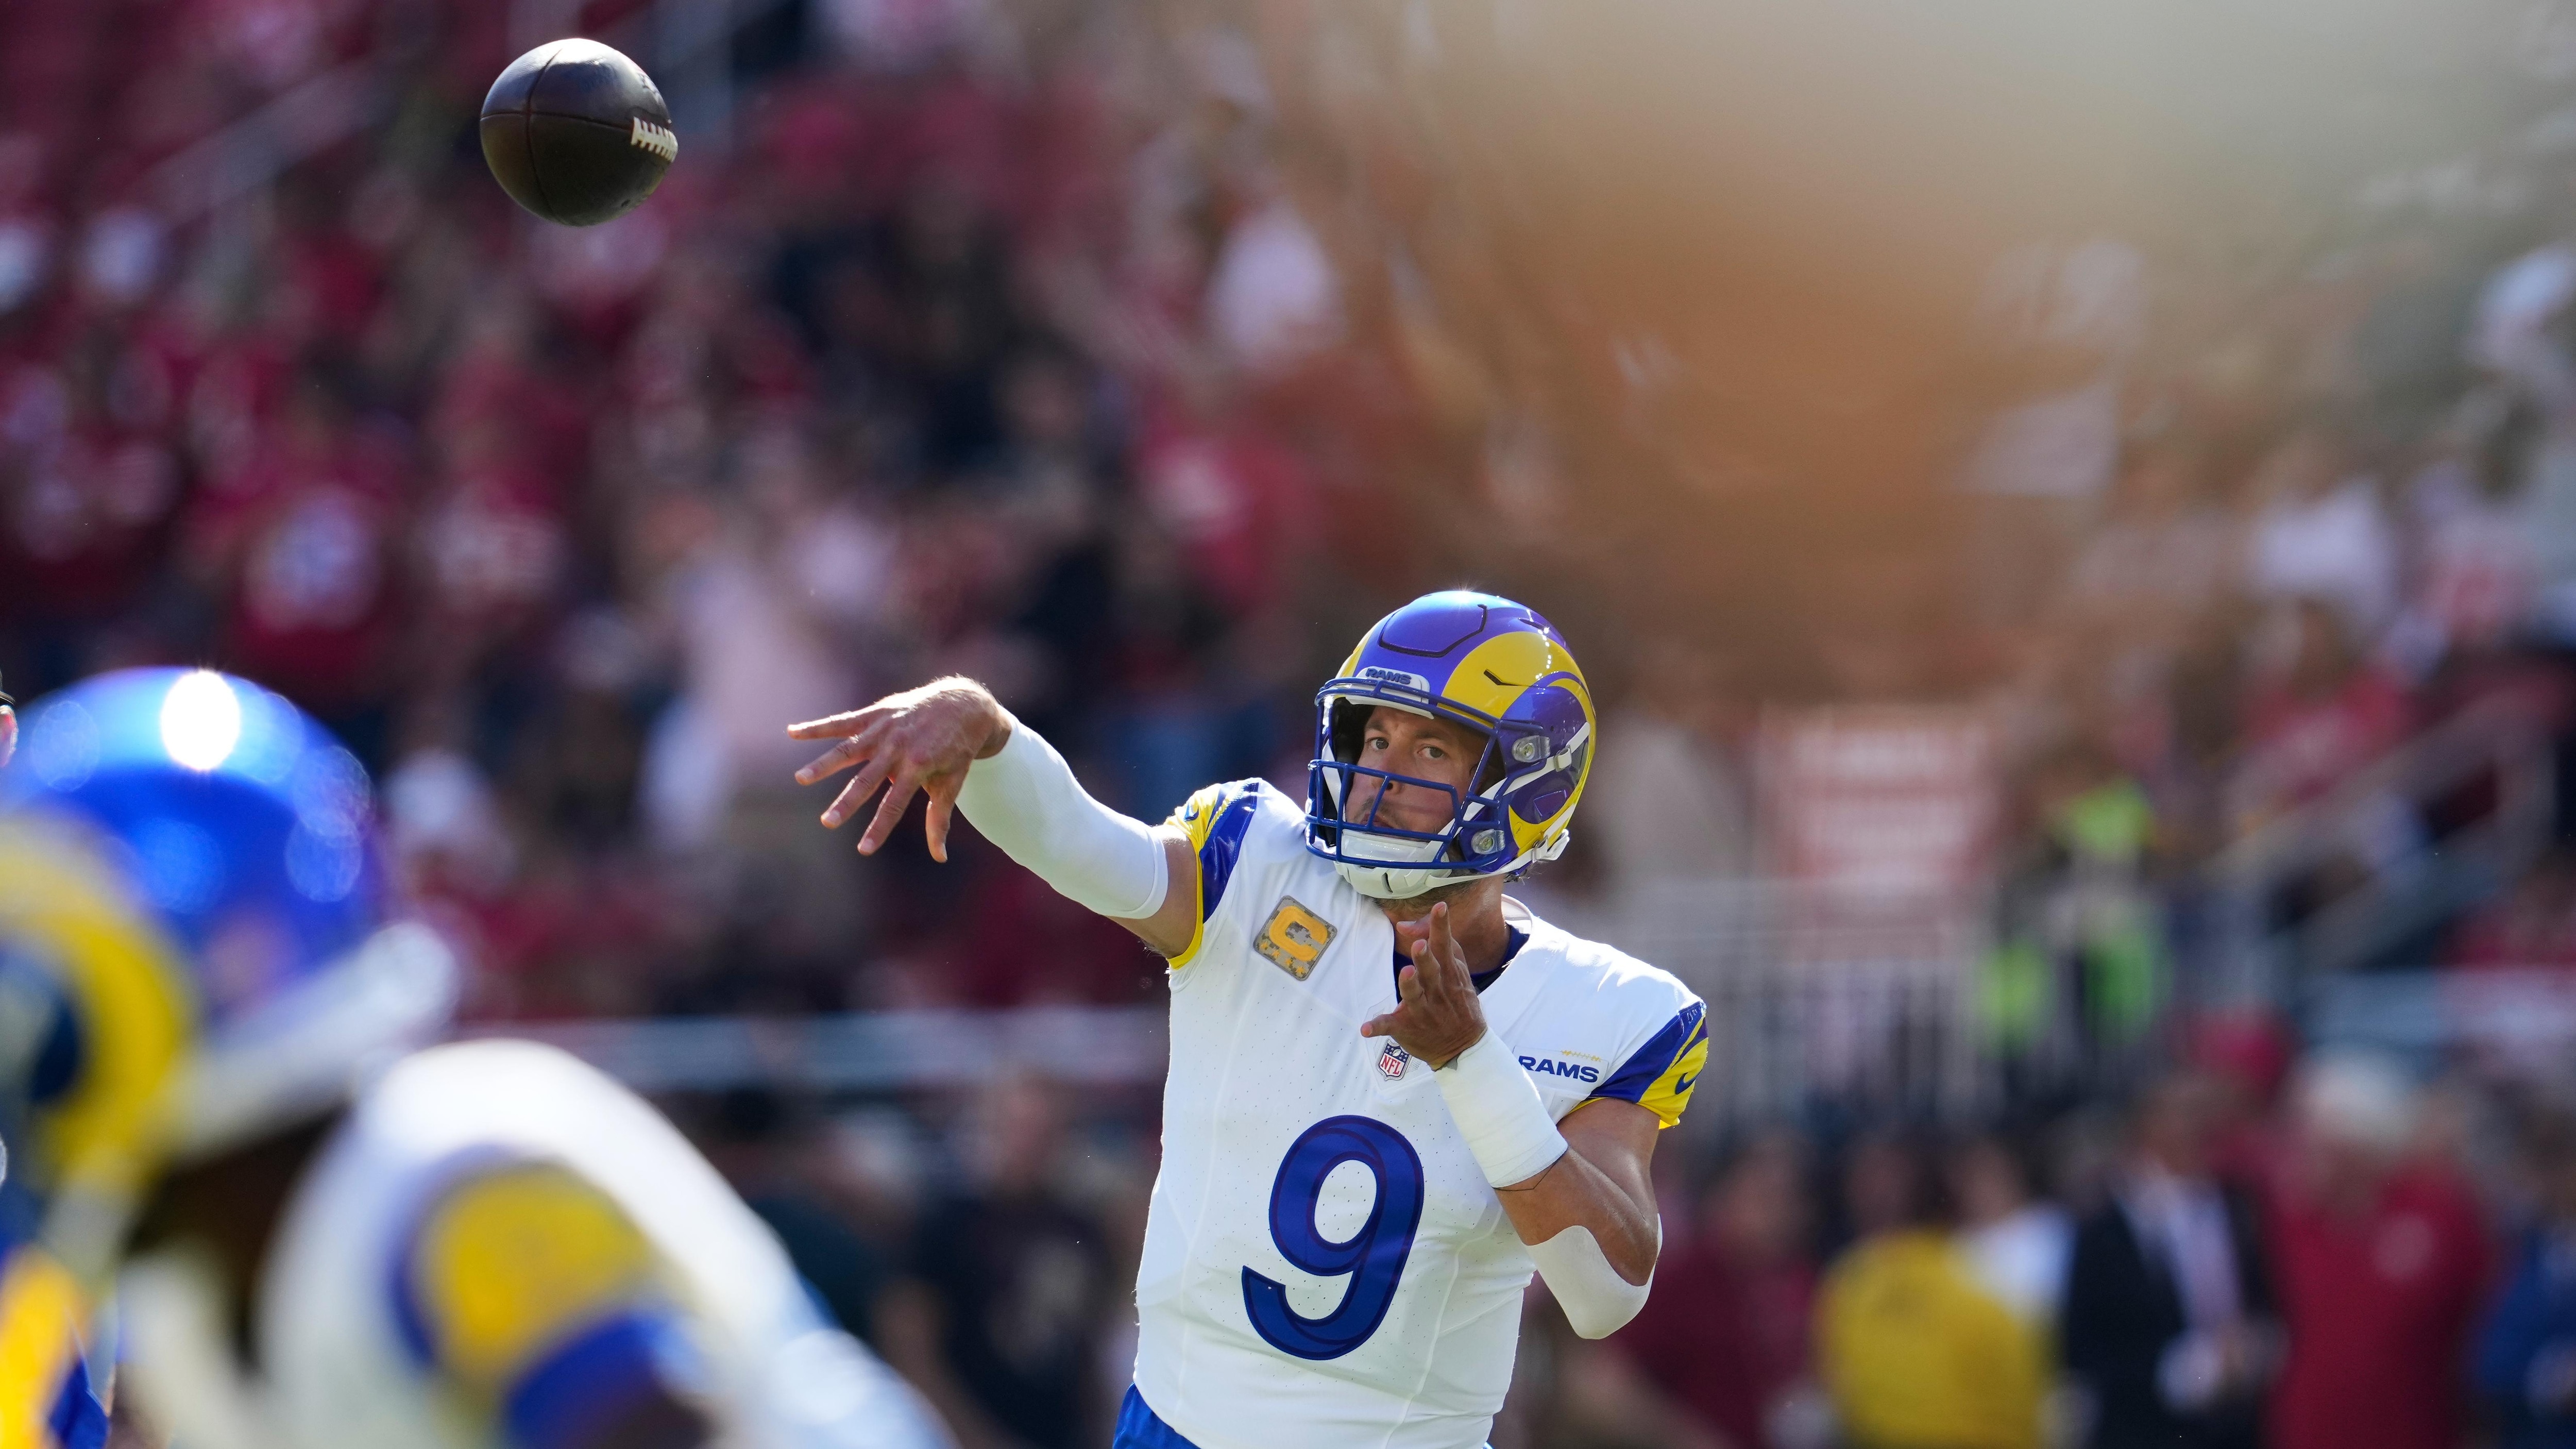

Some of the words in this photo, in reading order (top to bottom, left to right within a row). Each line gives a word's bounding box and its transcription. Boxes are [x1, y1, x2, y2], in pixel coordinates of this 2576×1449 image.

[1365, 668, 1412, 685] RAMS
[1269, 905, 1328, 962] C
[1380, 1054, 1401, 1075] NFL
[1518, 1055, 1599, 1083] RAMS
[1241, 1115, 1425, 1360] 9
